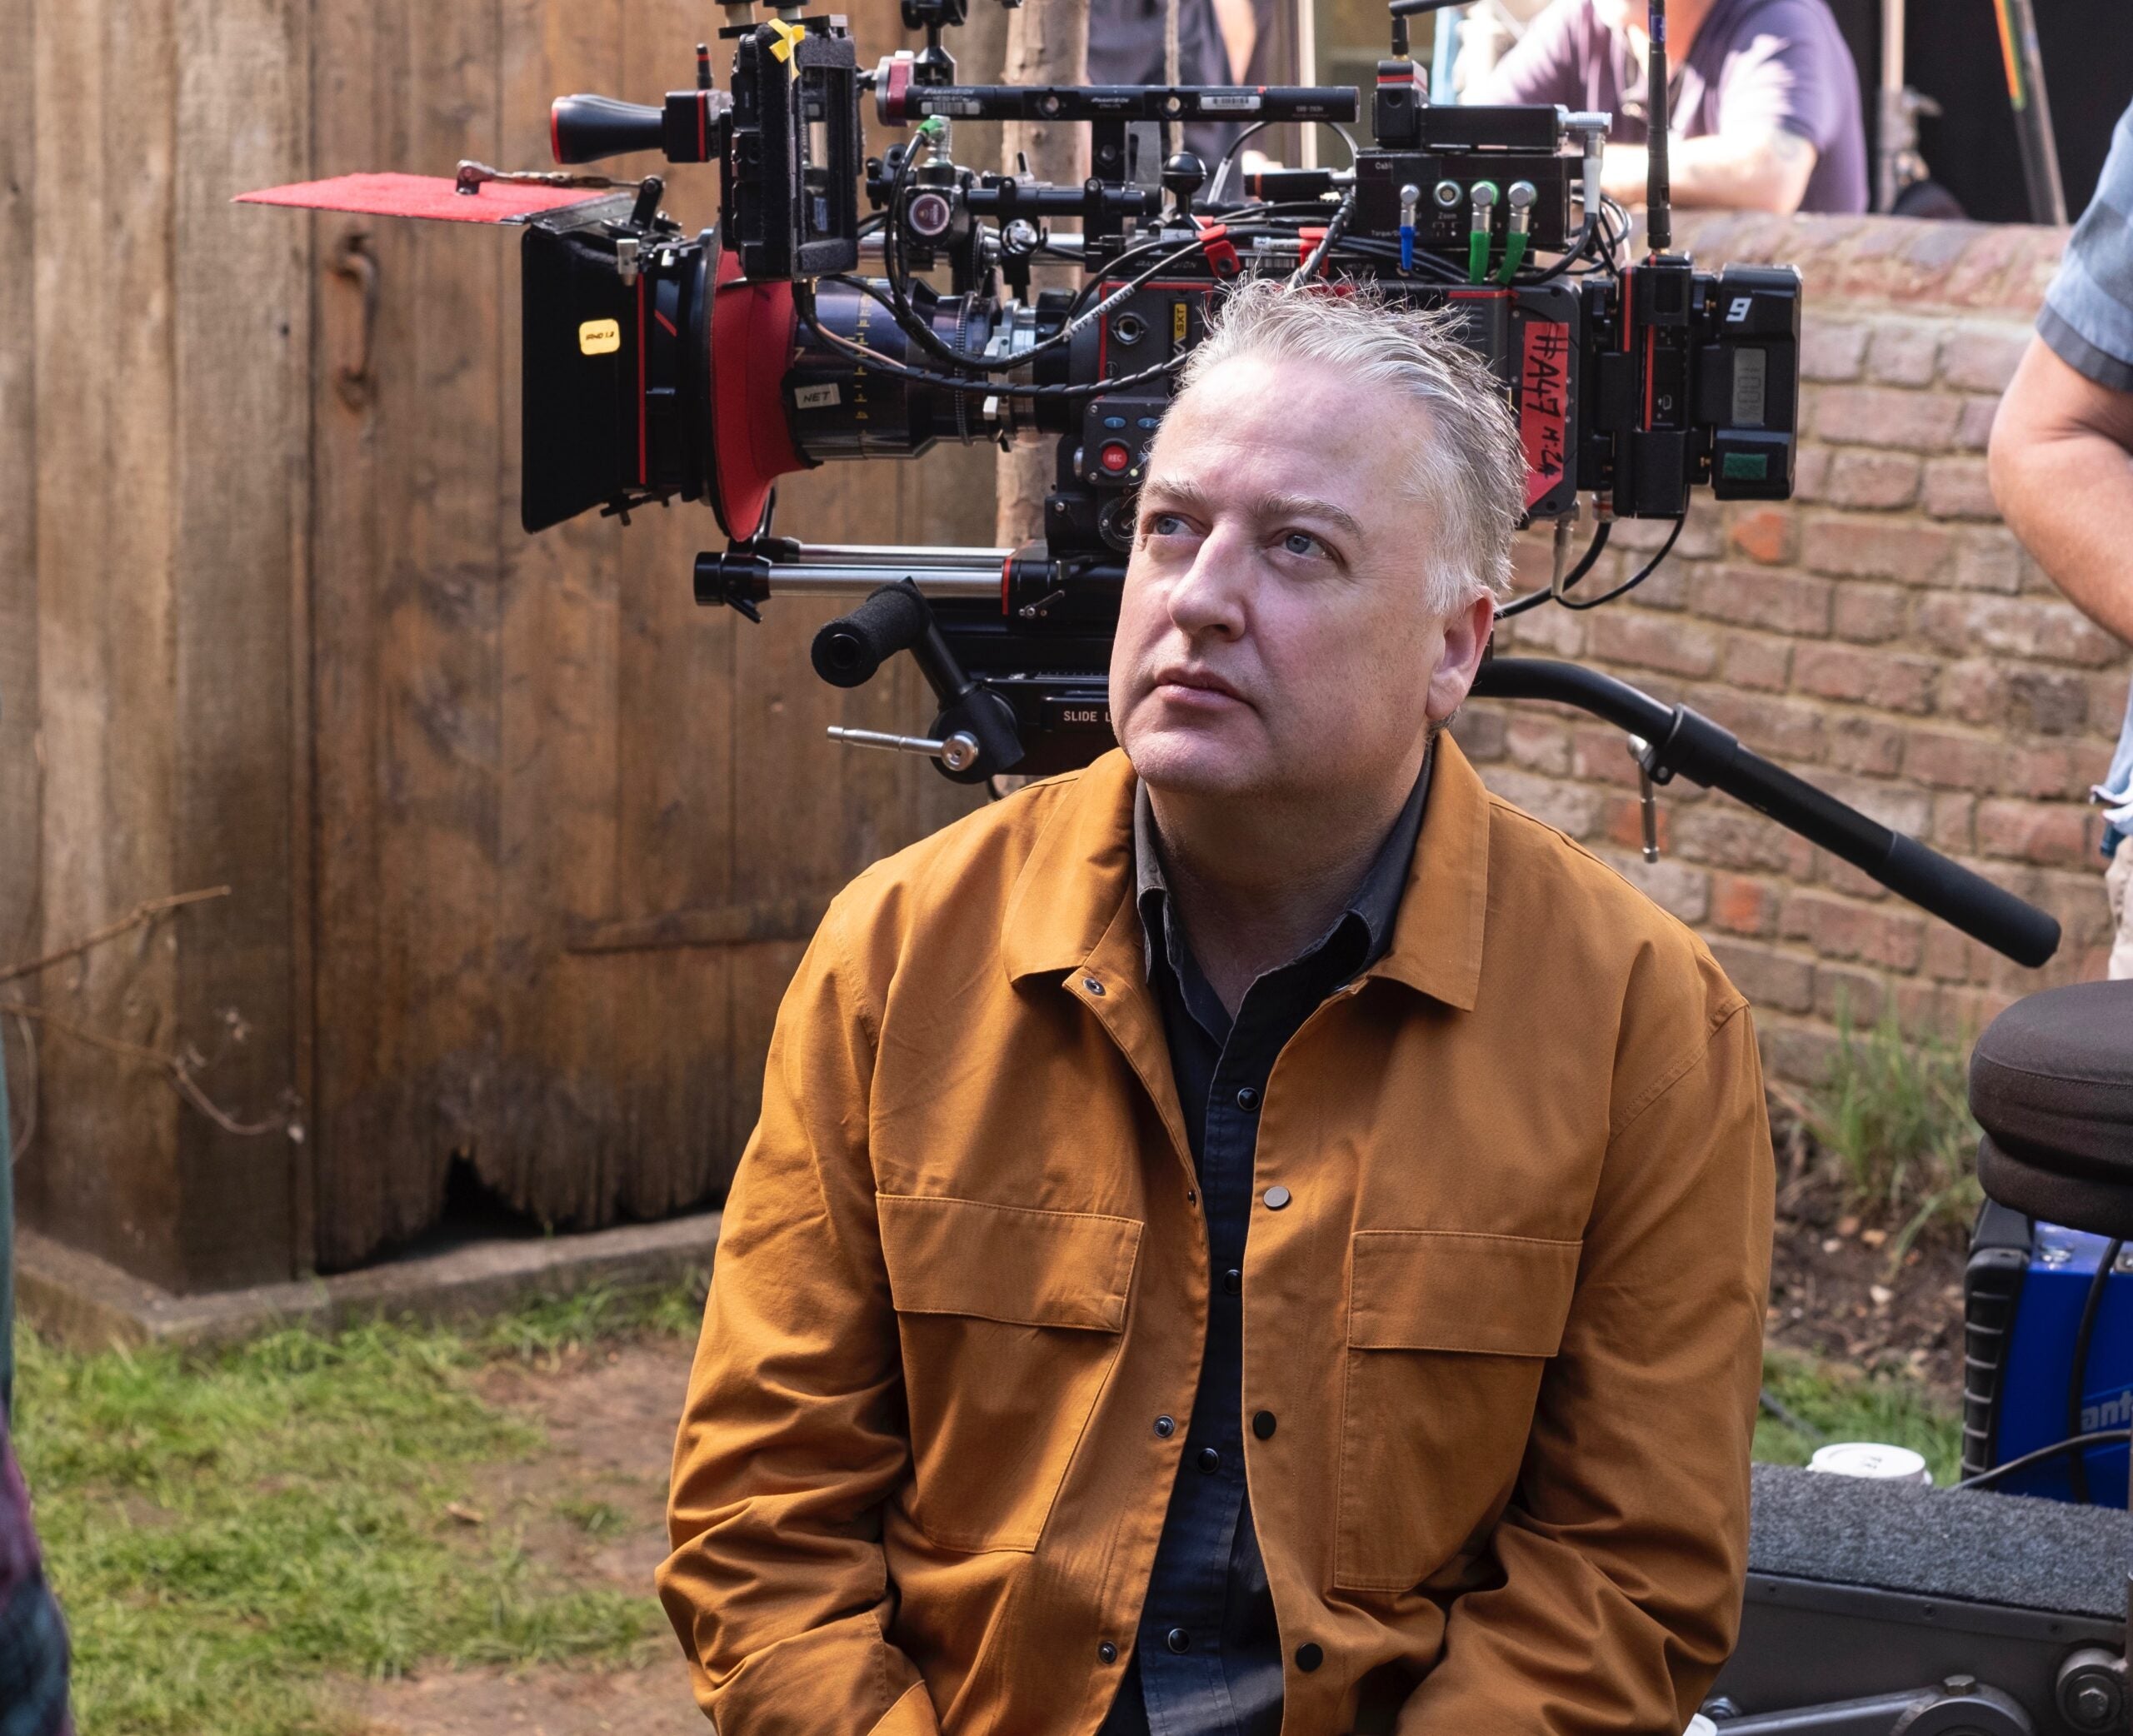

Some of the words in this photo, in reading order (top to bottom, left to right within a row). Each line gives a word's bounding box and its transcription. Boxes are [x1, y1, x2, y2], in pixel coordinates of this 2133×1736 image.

[1176, 307, 1185, 332] SXT
[802, 391, 831, 403] NET
[1107, 454, 1122, 462] REC
[1063, 710, 1098, 722] SLIDE
